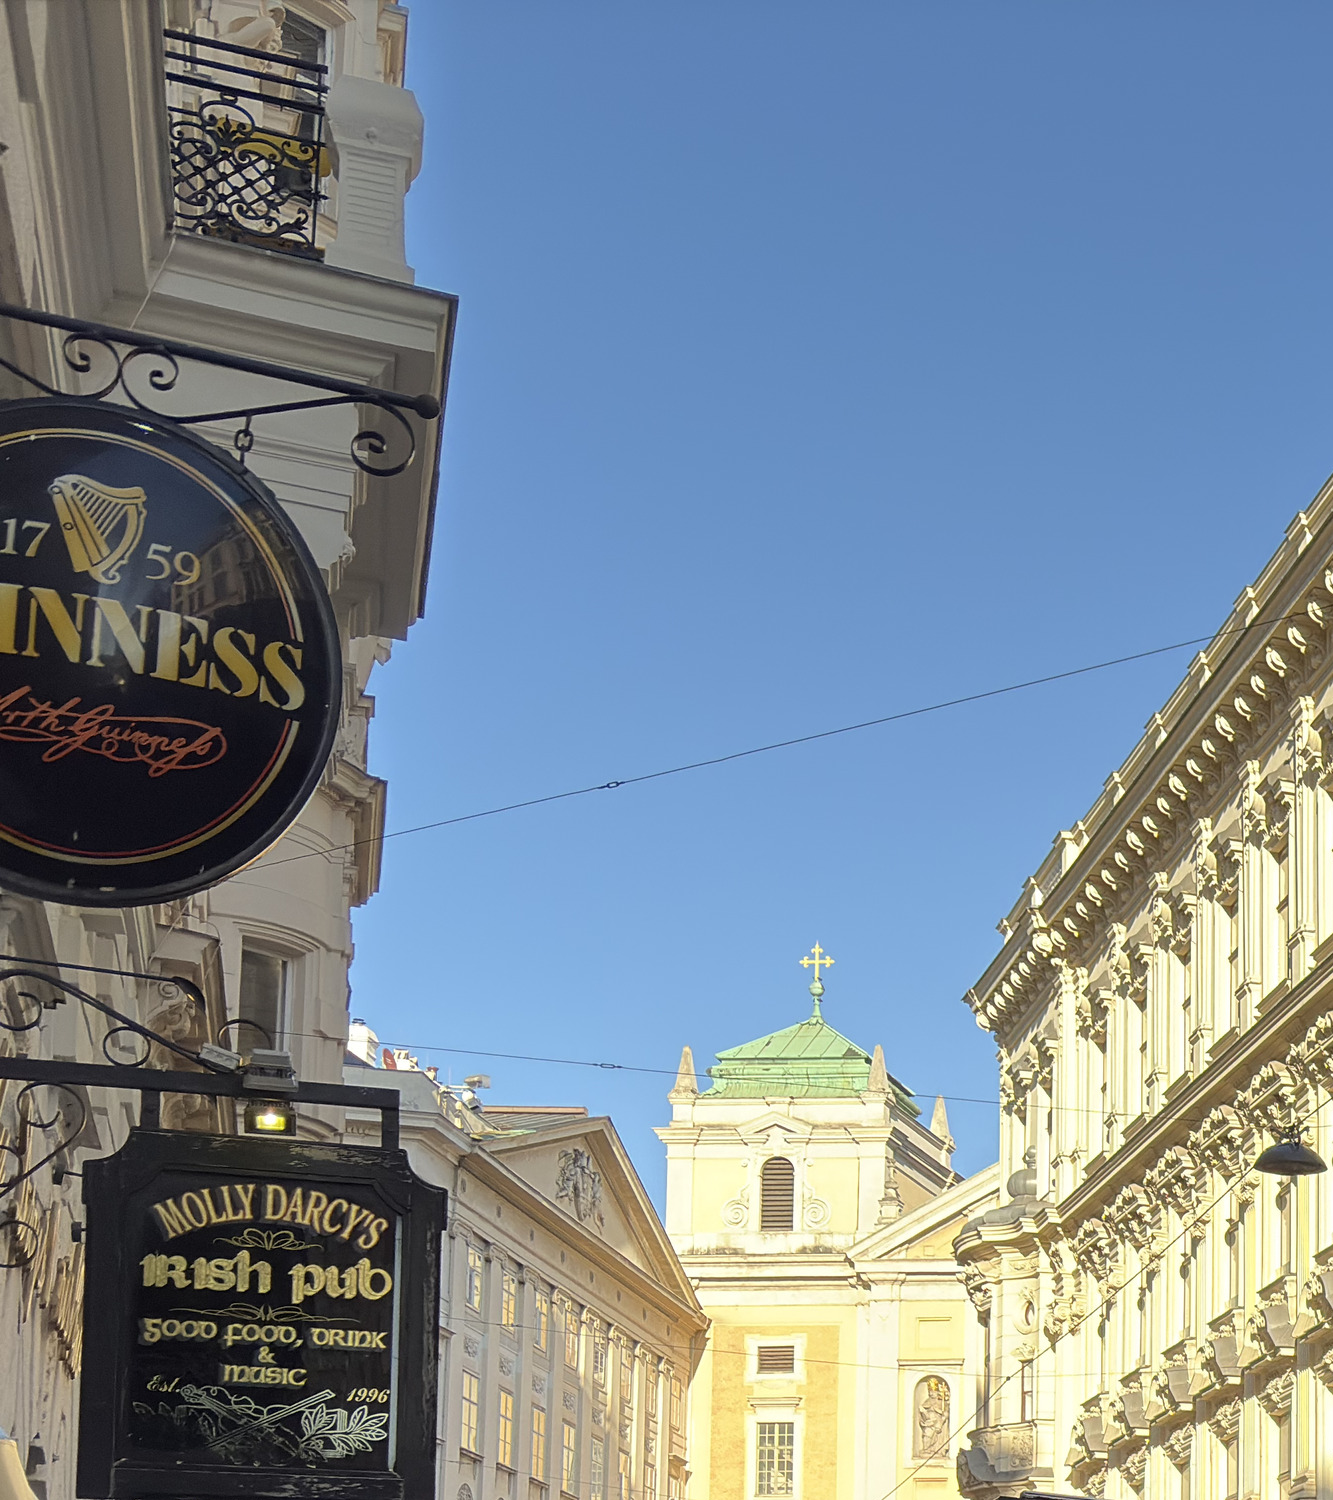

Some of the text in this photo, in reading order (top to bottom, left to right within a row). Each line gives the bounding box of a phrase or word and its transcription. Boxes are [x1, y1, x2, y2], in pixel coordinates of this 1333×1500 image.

[2, 517, 201, 586] 17 59
[153, 1183, 389, 1250] MOLLY DARCY'S
[256, 1345, 278, 1364] &
[346, 1387, 391, 1404] 1996
